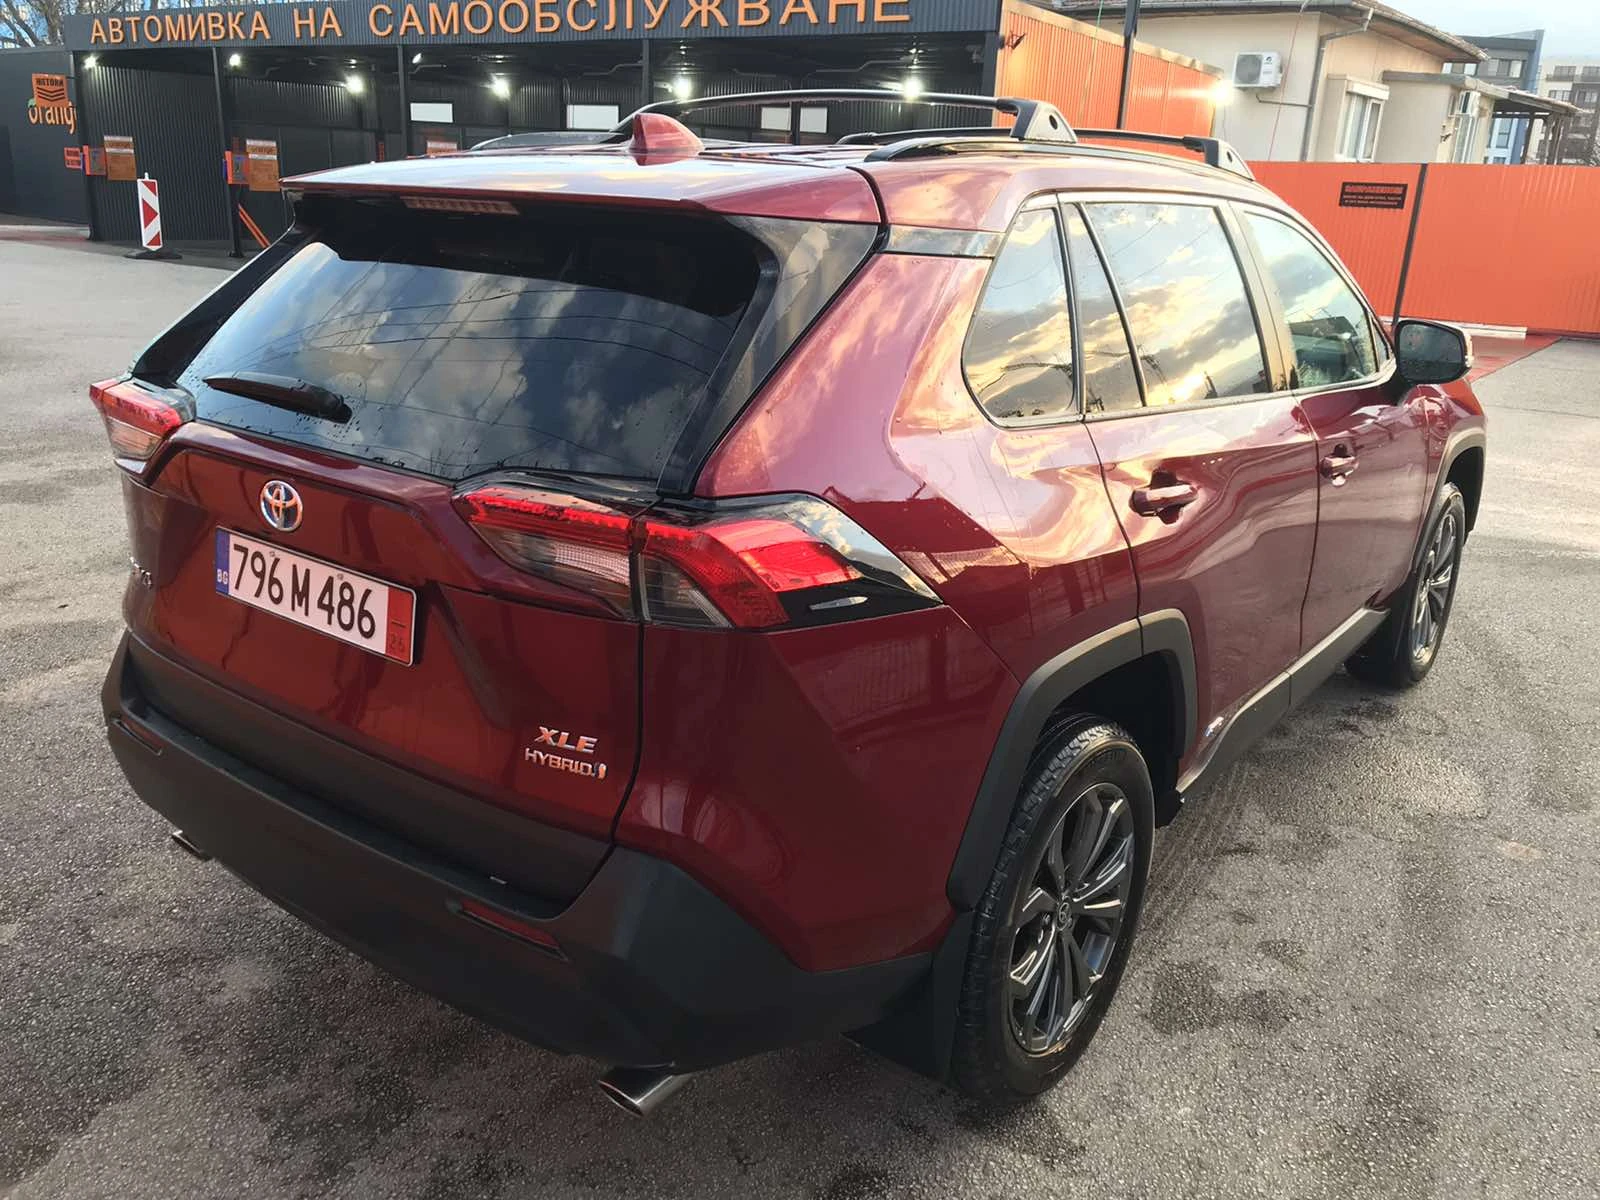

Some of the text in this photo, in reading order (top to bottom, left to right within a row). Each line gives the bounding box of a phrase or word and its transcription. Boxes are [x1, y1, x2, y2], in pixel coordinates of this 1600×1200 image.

[90, 0, 910, 44] АВТОМИВКА НА САМООБСЛУЖВАНЕ
[216, 569, 228, 585] BG
[233, 543, 376, 639] 796 M 486
[534, 726, 599, 754] XLE
[524, 747, 593, 777] HYBRID
